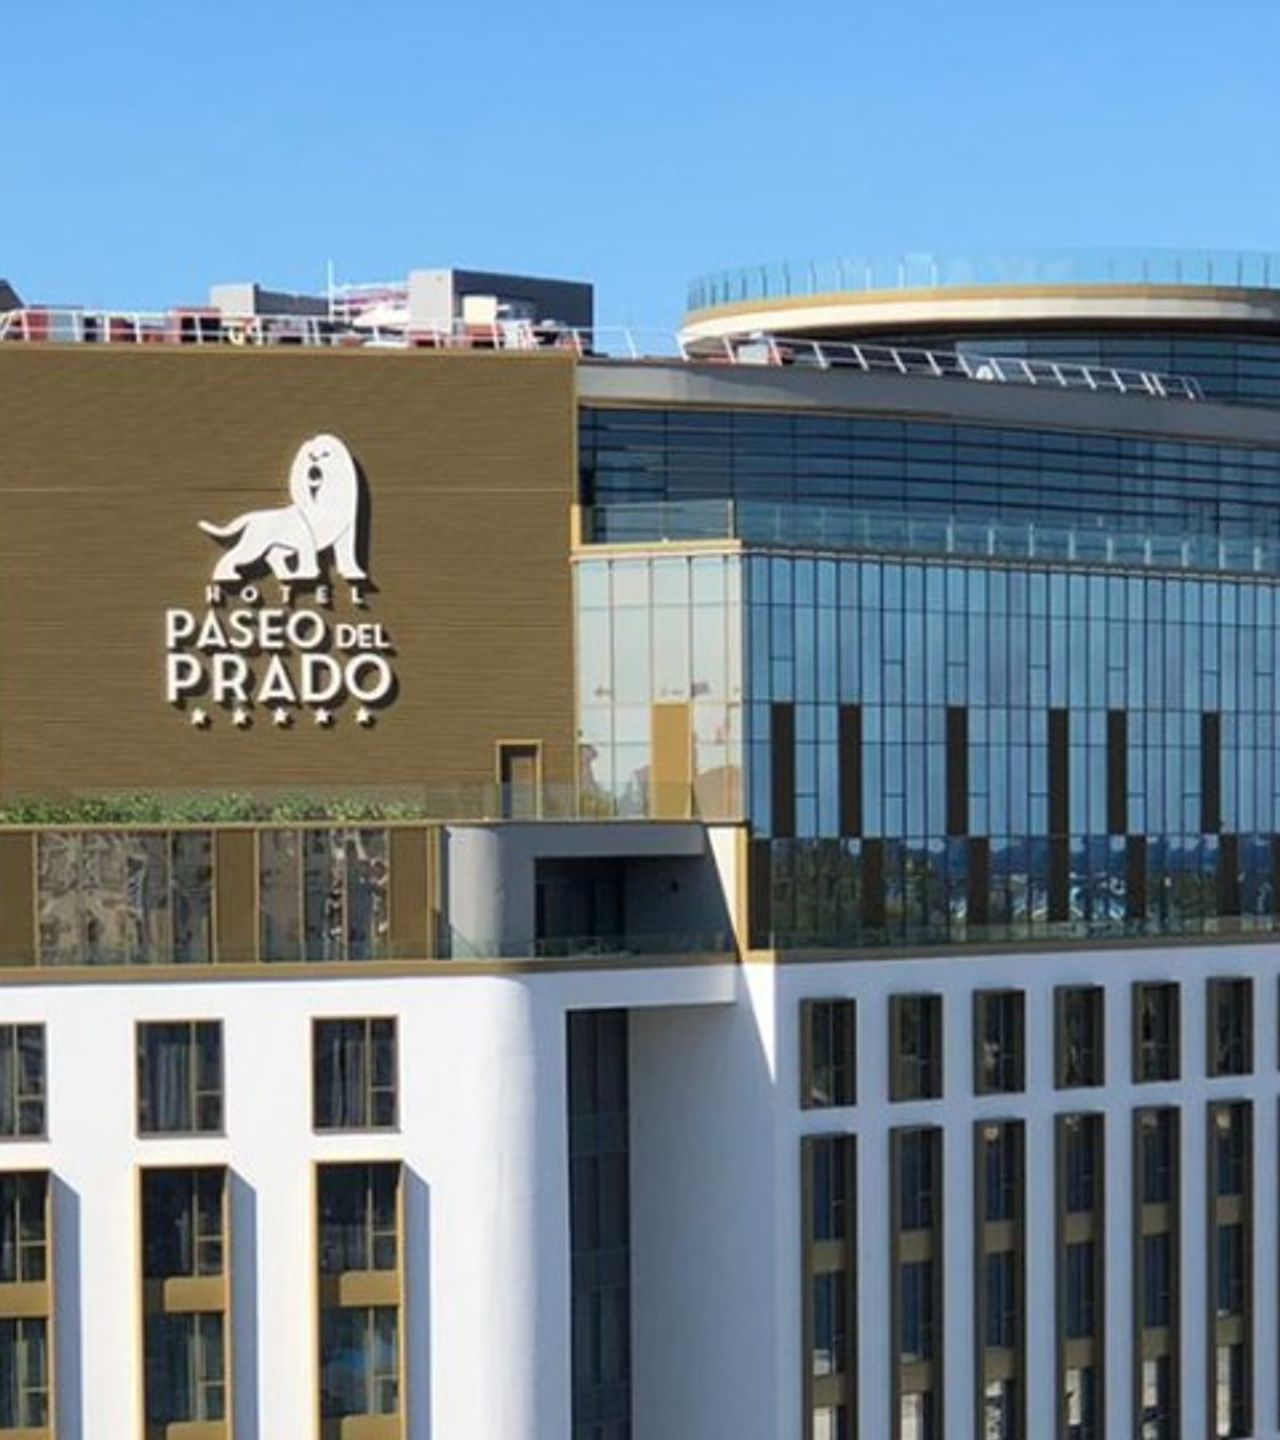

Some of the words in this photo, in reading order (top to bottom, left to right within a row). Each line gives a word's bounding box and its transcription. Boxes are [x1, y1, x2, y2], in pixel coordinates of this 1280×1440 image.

[205, 586, 365, 603] HOTEL
[166, 609, 324, 648] PASEO
[336, 624, 390, 648] DEL
[167, 653, 392, 702] PRADO
